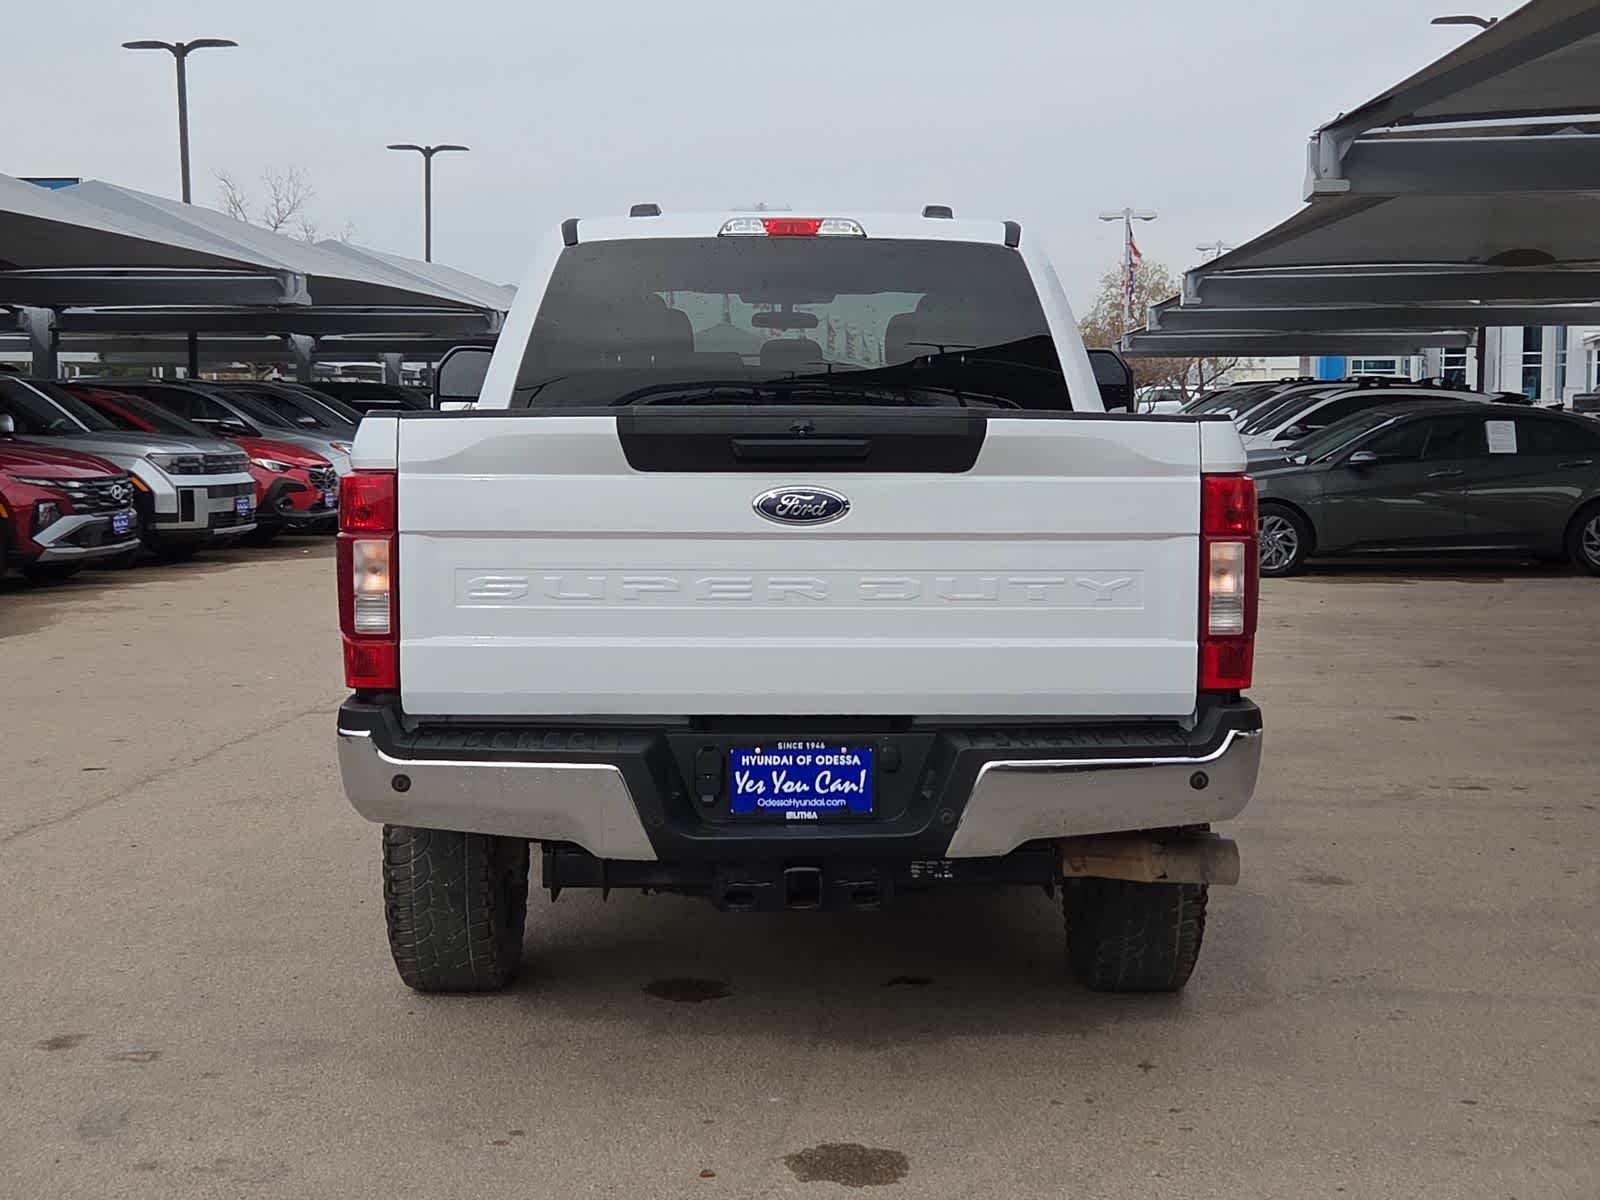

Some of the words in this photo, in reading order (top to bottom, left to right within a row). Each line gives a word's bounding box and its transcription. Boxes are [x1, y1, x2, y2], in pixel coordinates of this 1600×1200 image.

[776, 494, 827, 515] Ford
[467, 576, 829, 600] SUPER
[859, 576, 1133, 601] DUTY
[777, 741, 803, 750] SINCE
[741, 755, 793, 766] HYUNDAI
[796, 755, 812, 766] OF
[815, 755, 861, 766] ODESSA
[735, 770, 766, 794] Yes
[771, 770, 809, 794] You
[815, 769, 866, 794] Can!
[757, 798, 847, 808] OdessaHyundai.com
